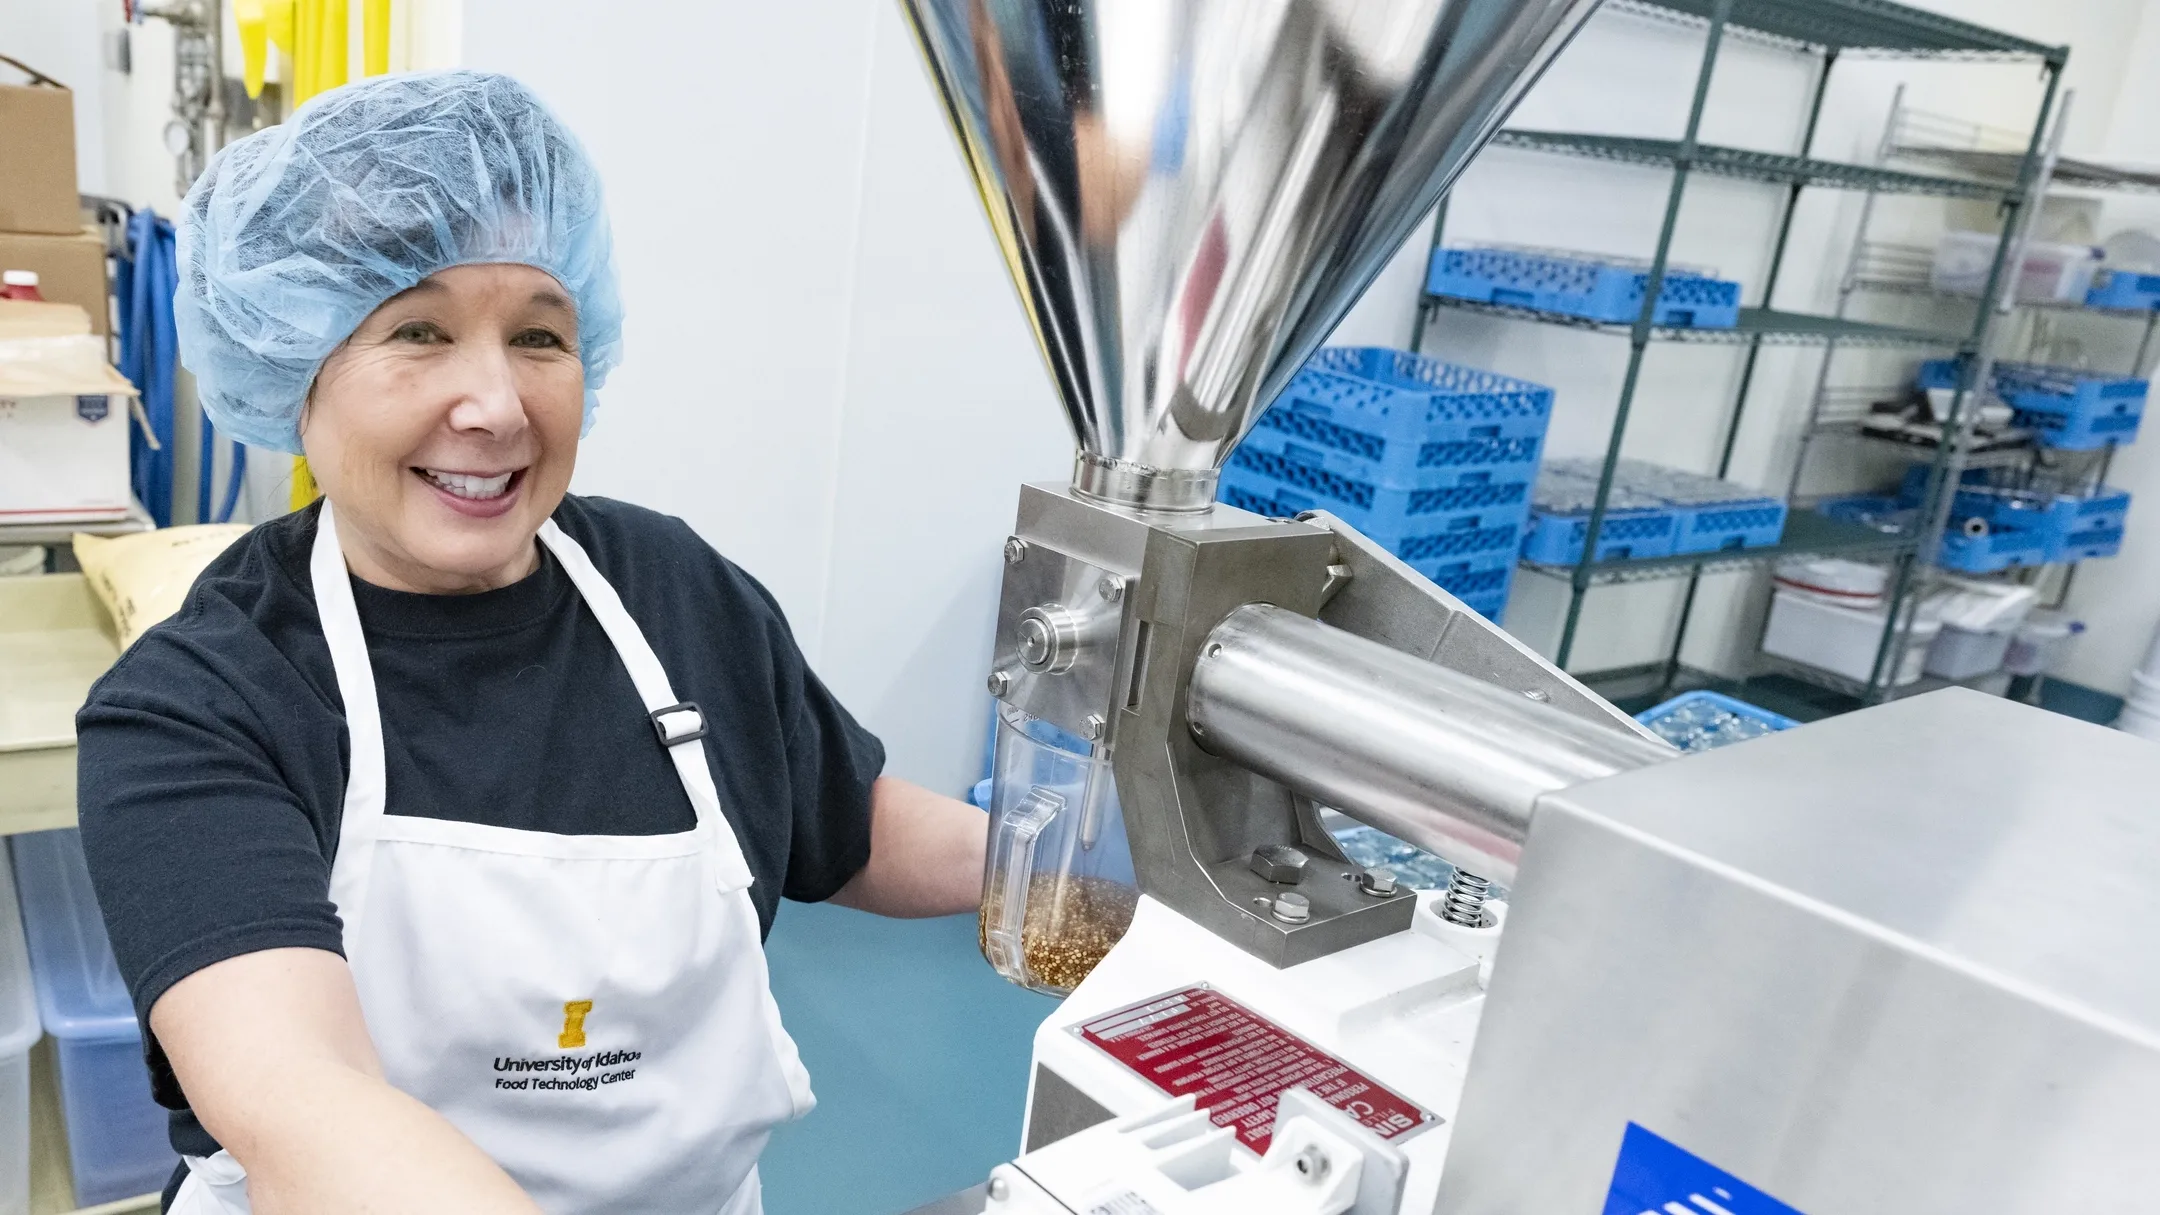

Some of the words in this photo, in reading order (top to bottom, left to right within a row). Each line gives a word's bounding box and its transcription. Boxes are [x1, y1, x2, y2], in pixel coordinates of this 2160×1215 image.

[493, 1056, 582, 1075] University
[581, 1056, 595, 1071] of
[495, 1078, 528, 1090] Food
[532, 1075, 599, 1091] Technology
[600, 1069, 636, 1085] Center
[1315, 1081, 1341, 1094] THE
[1331, 1077, 1349, 1087] IF
[1252, 1094, 1280, 1107] NOT
[1322, 1081, 1371, 1105] PERSONAL
[1208, 1100, 1263, 1126] OBSERVED
[1236, 1108, 1278, 1128] SAFETY
